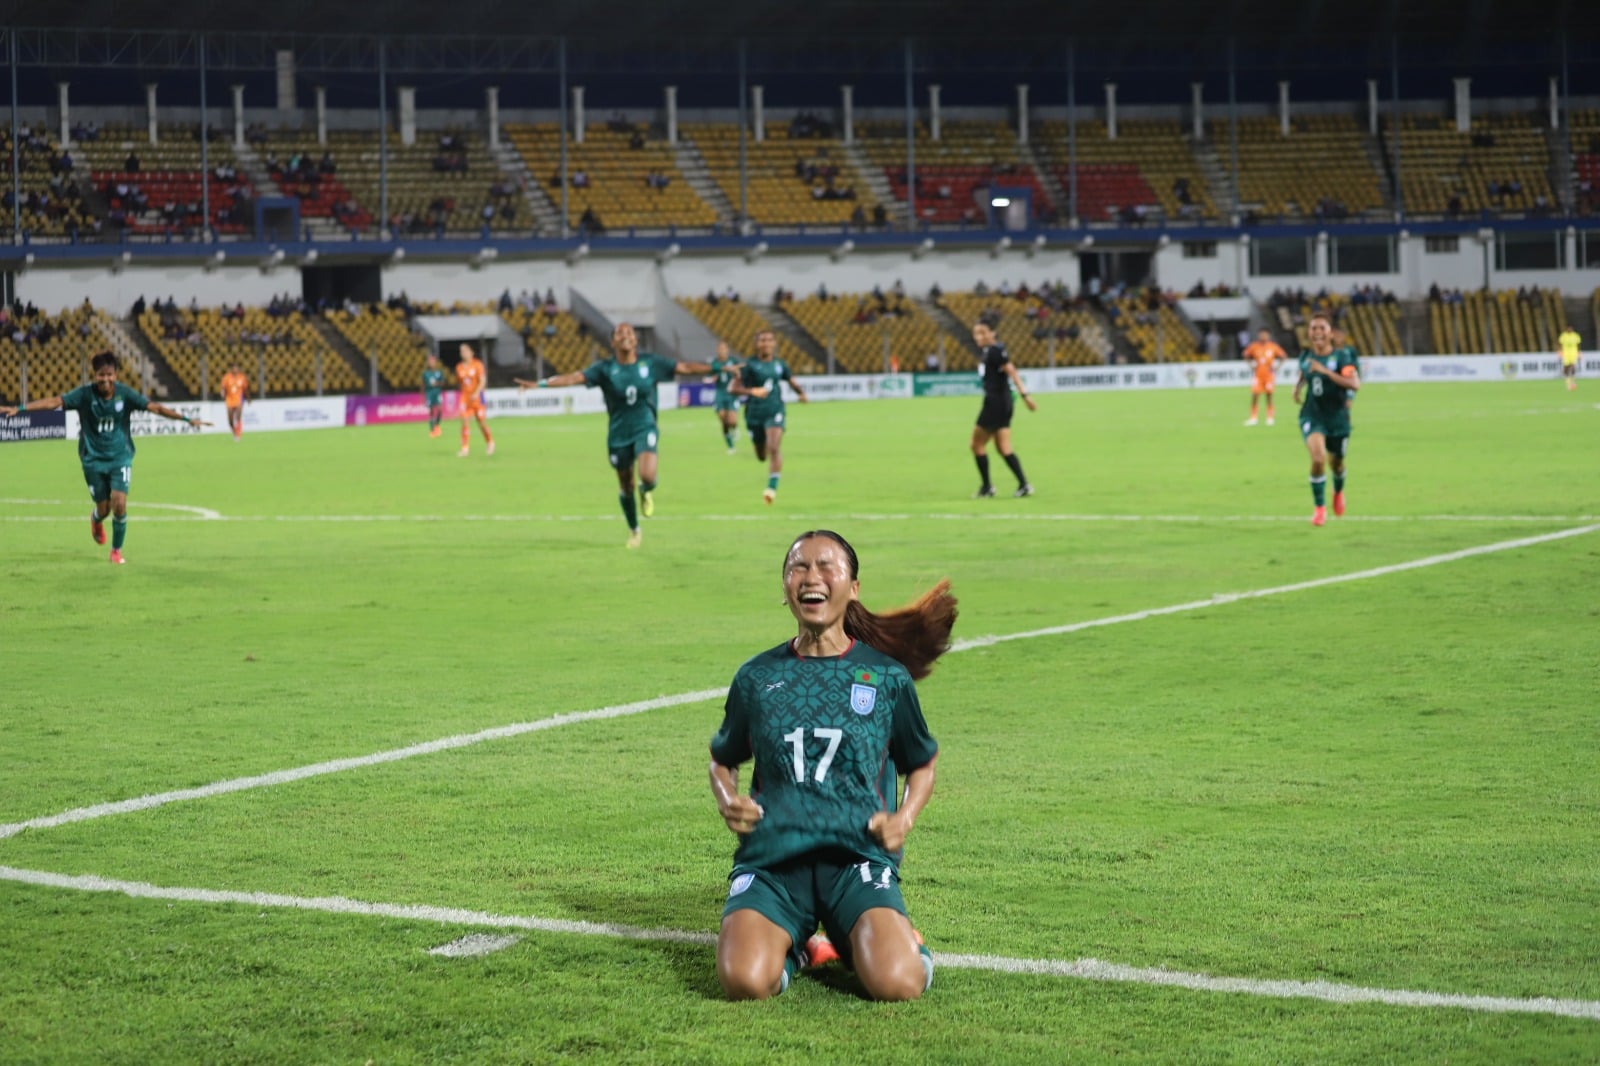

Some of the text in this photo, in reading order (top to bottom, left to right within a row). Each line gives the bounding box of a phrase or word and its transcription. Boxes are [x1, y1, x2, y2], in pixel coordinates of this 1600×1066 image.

[1312, 376, 1324, 397] 8
[8, 415, 31, 429] ASIAN
[21, 425, 66, 440] FEDERATION
[783, 726, 843, 784] 17
